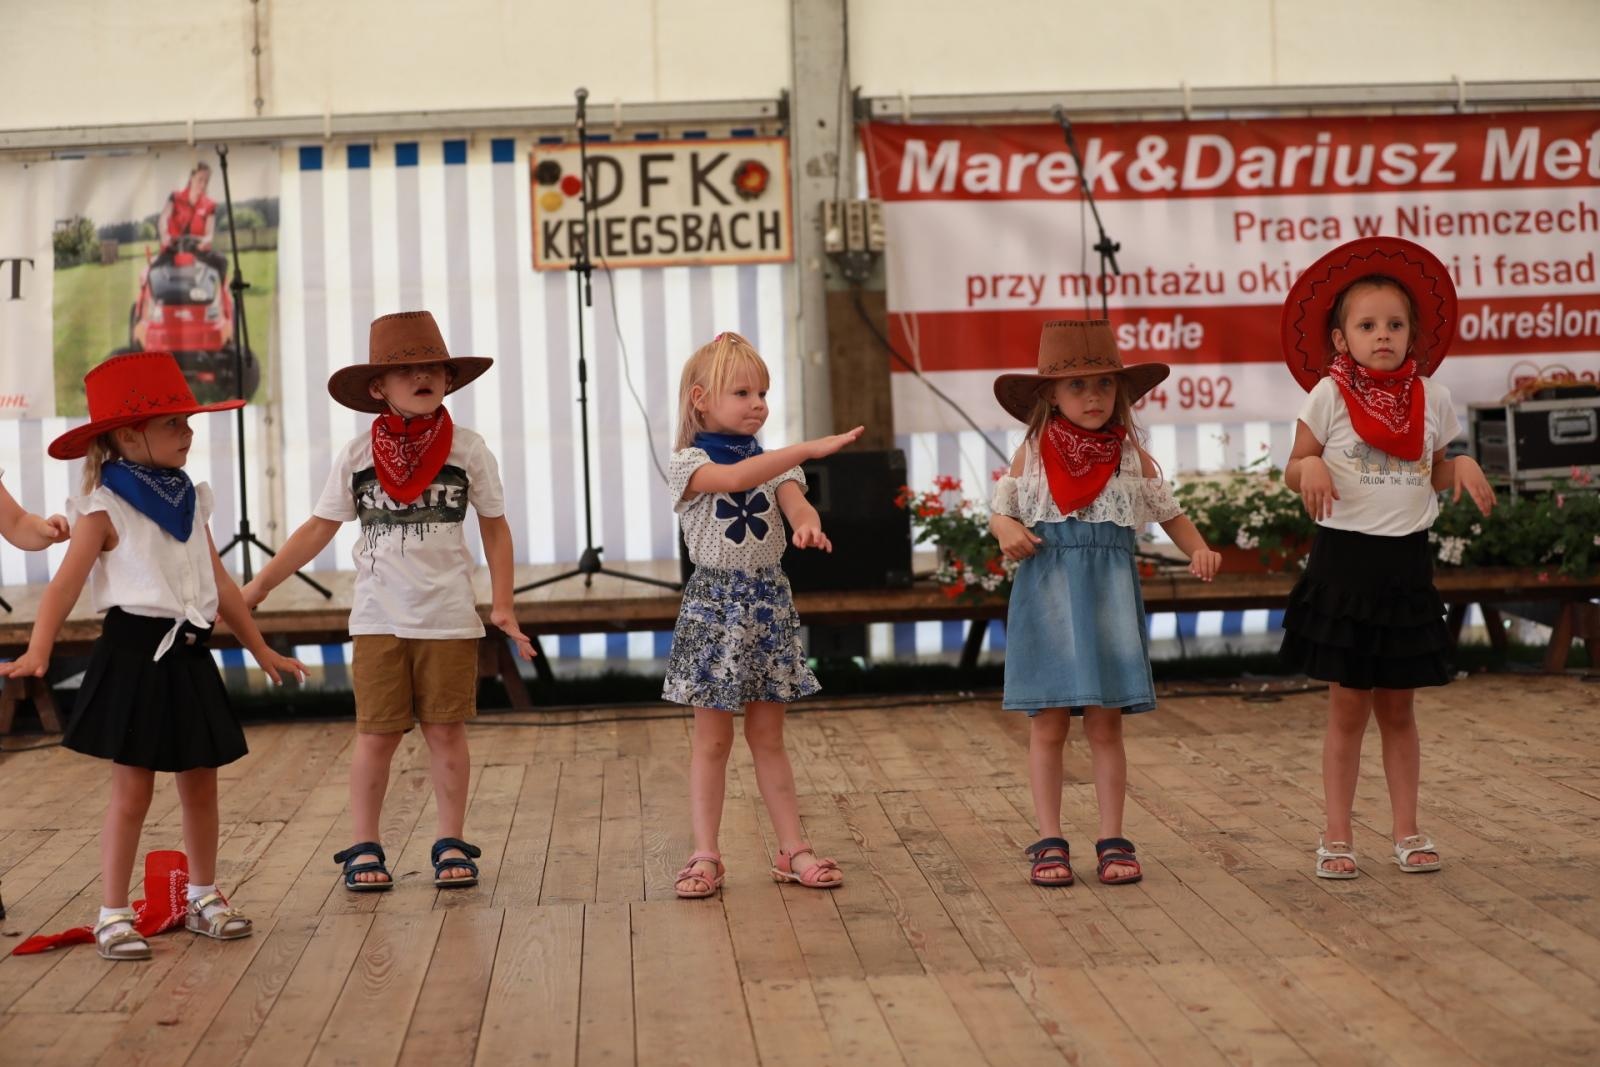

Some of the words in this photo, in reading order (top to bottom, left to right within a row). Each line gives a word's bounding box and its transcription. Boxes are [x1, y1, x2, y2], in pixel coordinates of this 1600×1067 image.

[584, 152, 733, 212] DFK
[897, 131, 1458, 194] Marek&Dariusz
[1480, 126, 1600, 182] Met
[542, 210, 782, 260] KRIEGSBACH
[1233, 211, 1341, 243] Praca
[1354, 215, 1383, 238] w
[1396, 200, 1598, 239] Niemczech
[966, 273, 1046, 306] przy
[1059, 264, 1226, 298] montażu
[1473, 254, 1482, 287] i
[1493, 251, 1596, 287] fasad
[1117, 314, 1205, 351] stałe
[1459, 302, 1600, 341] określon
[1178, 376, 1236, 411] 992
[1360, 474, 1386, 485] FOLLOW
[1390, 475, 1402, 486] THE
